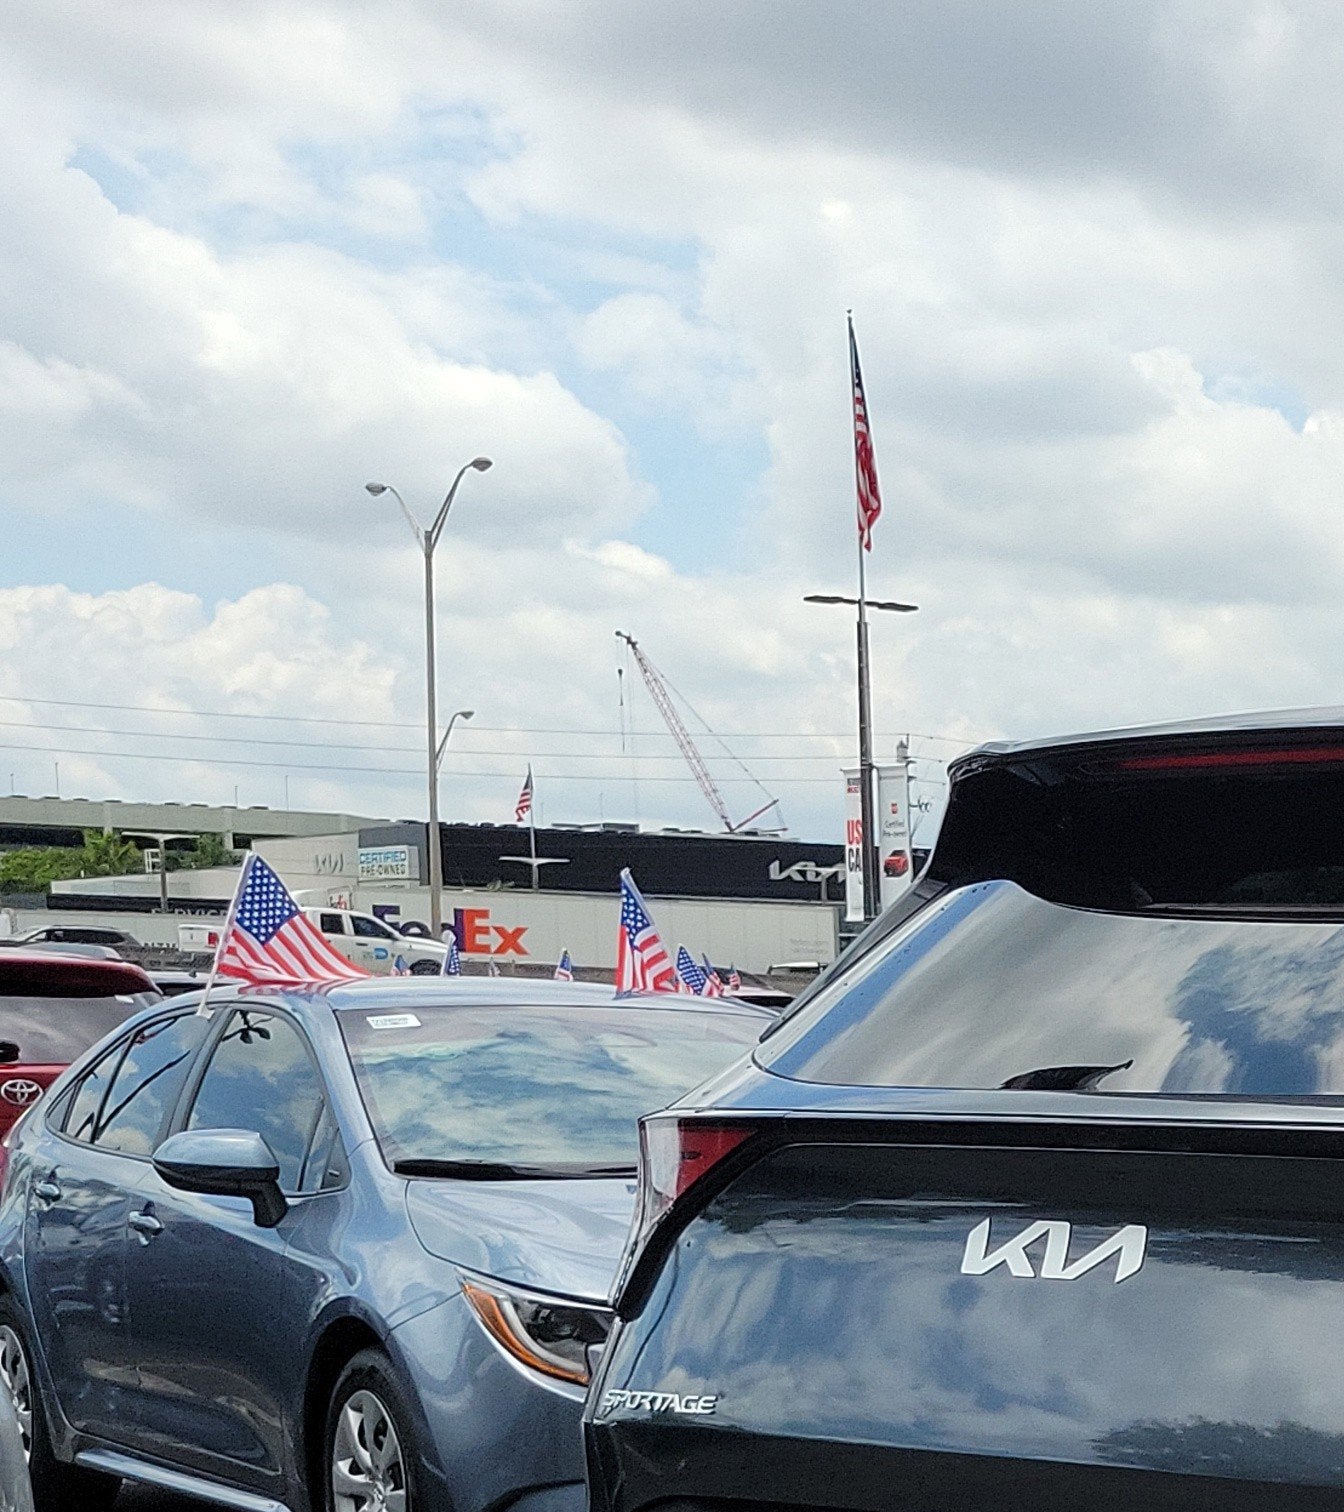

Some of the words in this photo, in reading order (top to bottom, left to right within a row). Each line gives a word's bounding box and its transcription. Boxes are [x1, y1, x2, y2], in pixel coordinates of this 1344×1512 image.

[360, 850, 407, 864] CERTIFIED
[961, 1217, 1148, 1284] KIA
[602, 1388, 718, 1418] SPORTAGE
